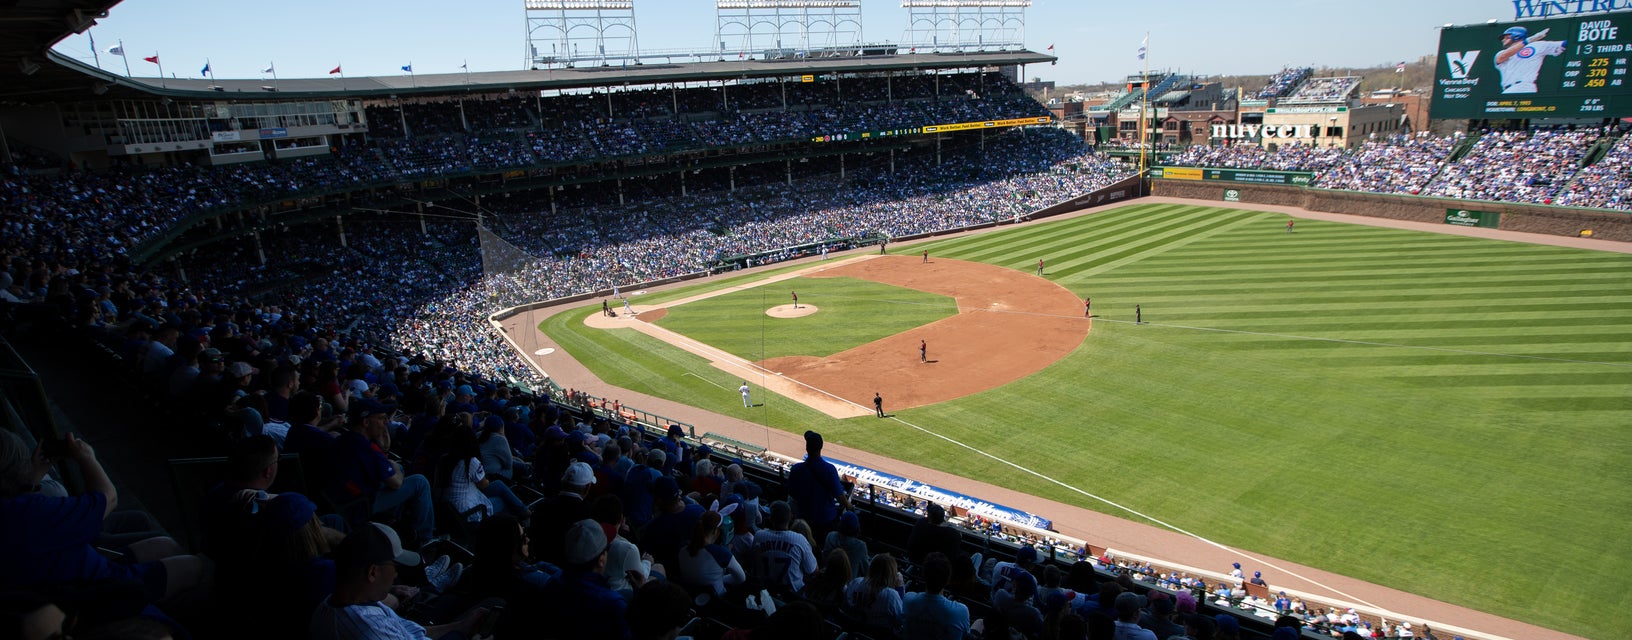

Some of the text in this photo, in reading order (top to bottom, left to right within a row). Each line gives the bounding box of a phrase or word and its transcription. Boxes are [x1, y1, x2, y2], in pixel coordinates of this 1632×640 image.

[1580, 20, 1611, 30] DAVID
[1578, 27, 1618, 42] BOTE
[1597, 44, 1624, 53] THIRD
[1588, 58, 1609, 67] .275
[1585, 68, 1607, 77] .370
[1584, 79, 1606, 87] .450
[1212, 124, 1312, 139] nuveen
